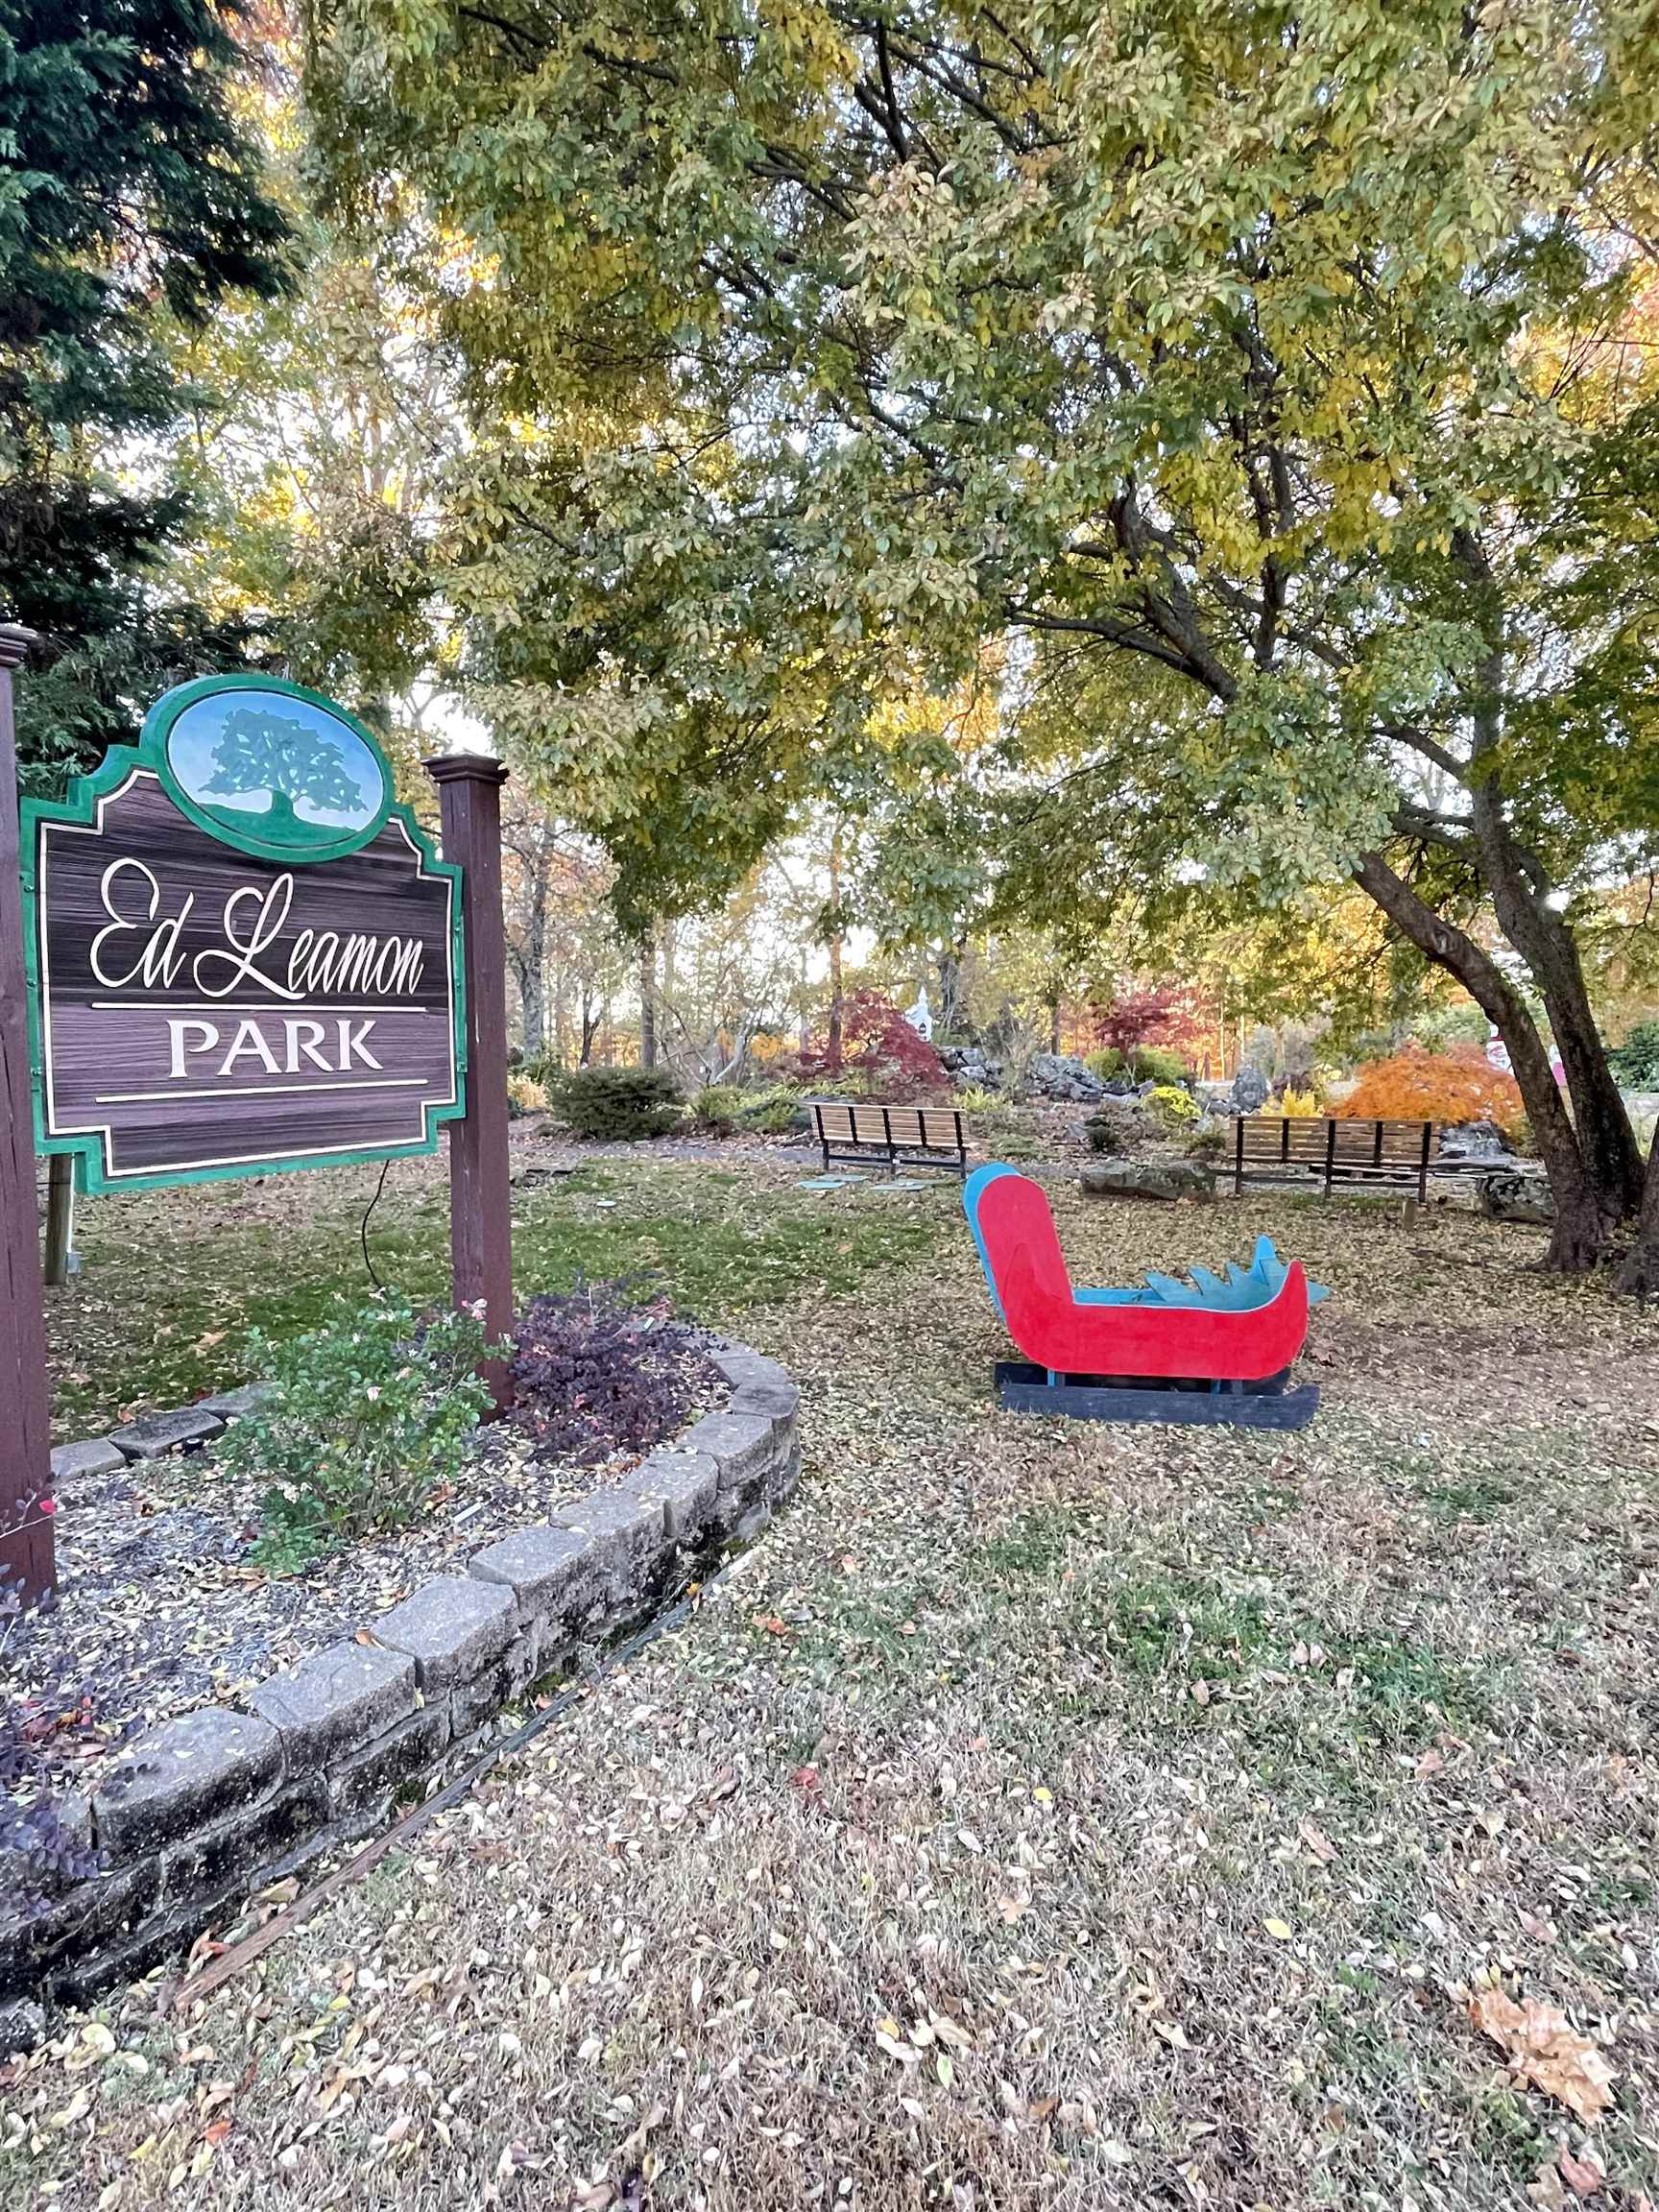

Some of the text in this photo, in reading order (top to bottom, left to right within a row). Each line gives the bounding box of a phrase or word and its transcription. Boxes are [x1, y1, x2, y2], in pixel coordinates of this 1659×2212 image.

[89, 857, 424, 1000] Ed Leamon
[166, 1020, 384, 1078] PARK
